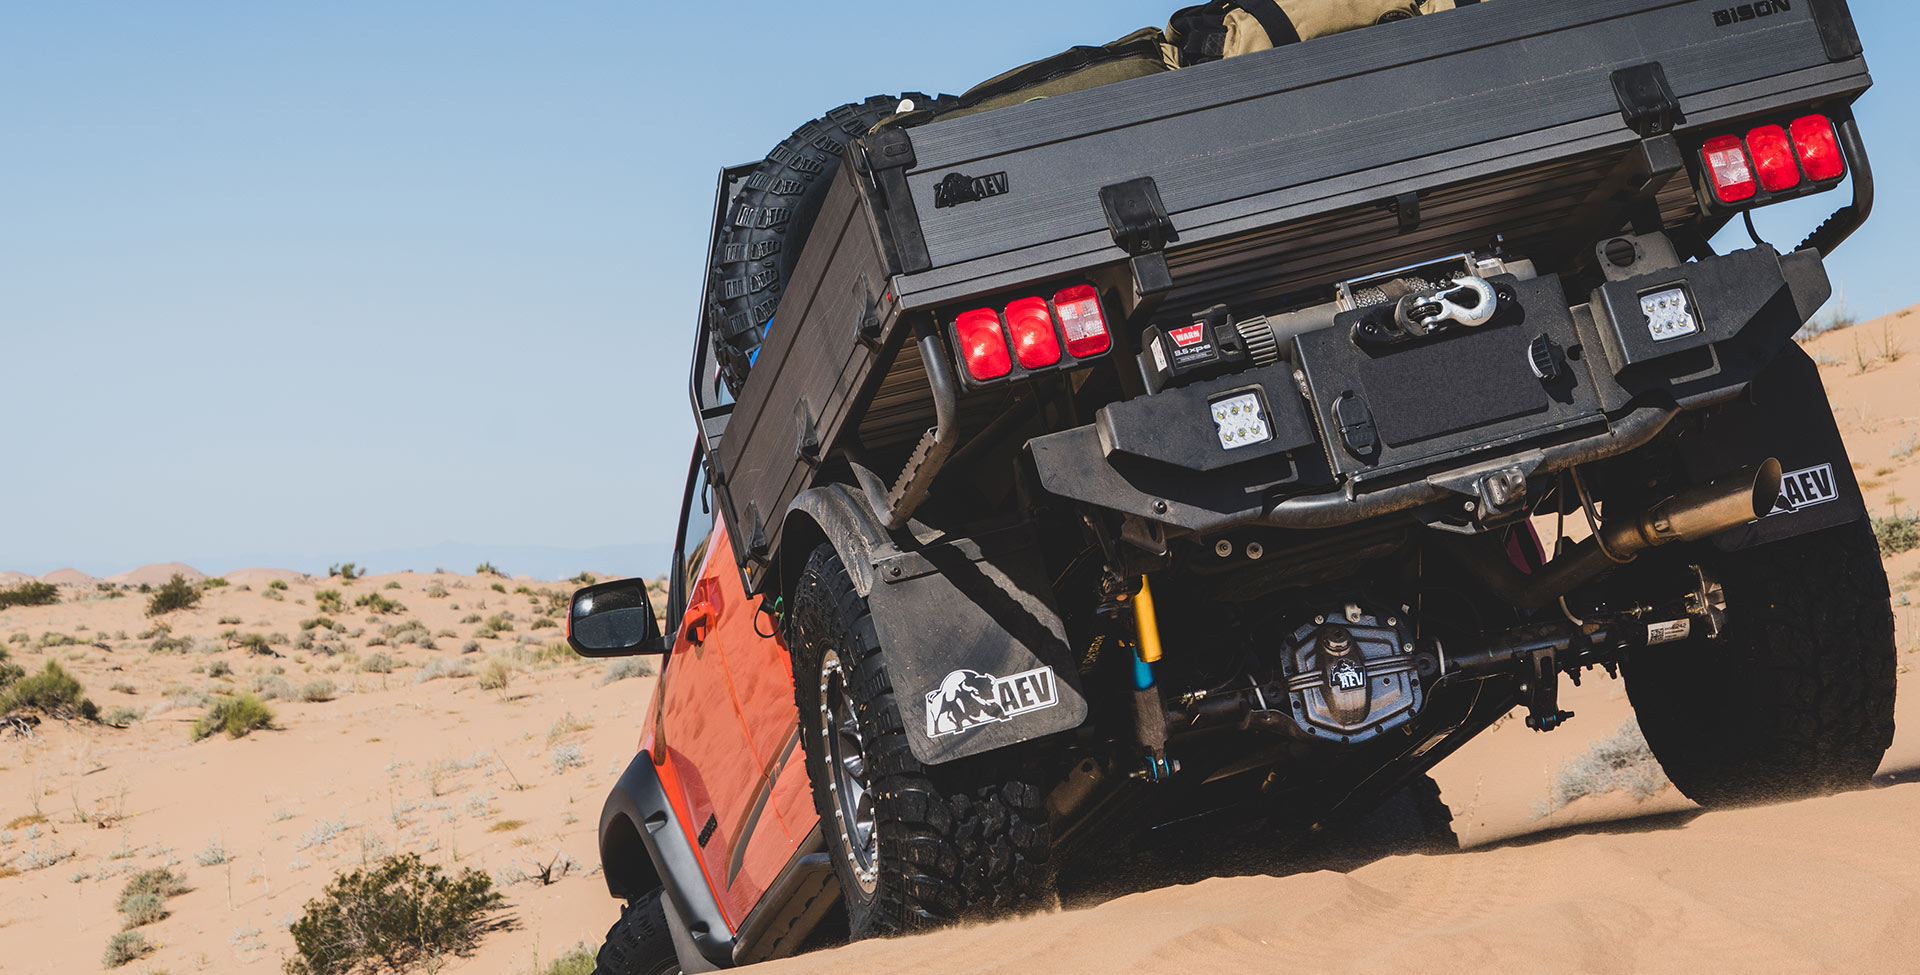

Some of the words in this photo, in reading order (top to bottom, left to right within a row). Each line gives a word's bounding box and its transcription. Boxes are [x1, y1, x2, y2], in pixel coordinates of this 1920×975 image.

[1712, 0, 1791, 27] BISON
[973, 172, 1007, 198] AEV
[1175, 330, 1200, 342] WARN
[1783, 468, 1833, 505] AEV
[998, 671, 1051, 712] AEV
[1340, 672, 1363, 688] AEV
